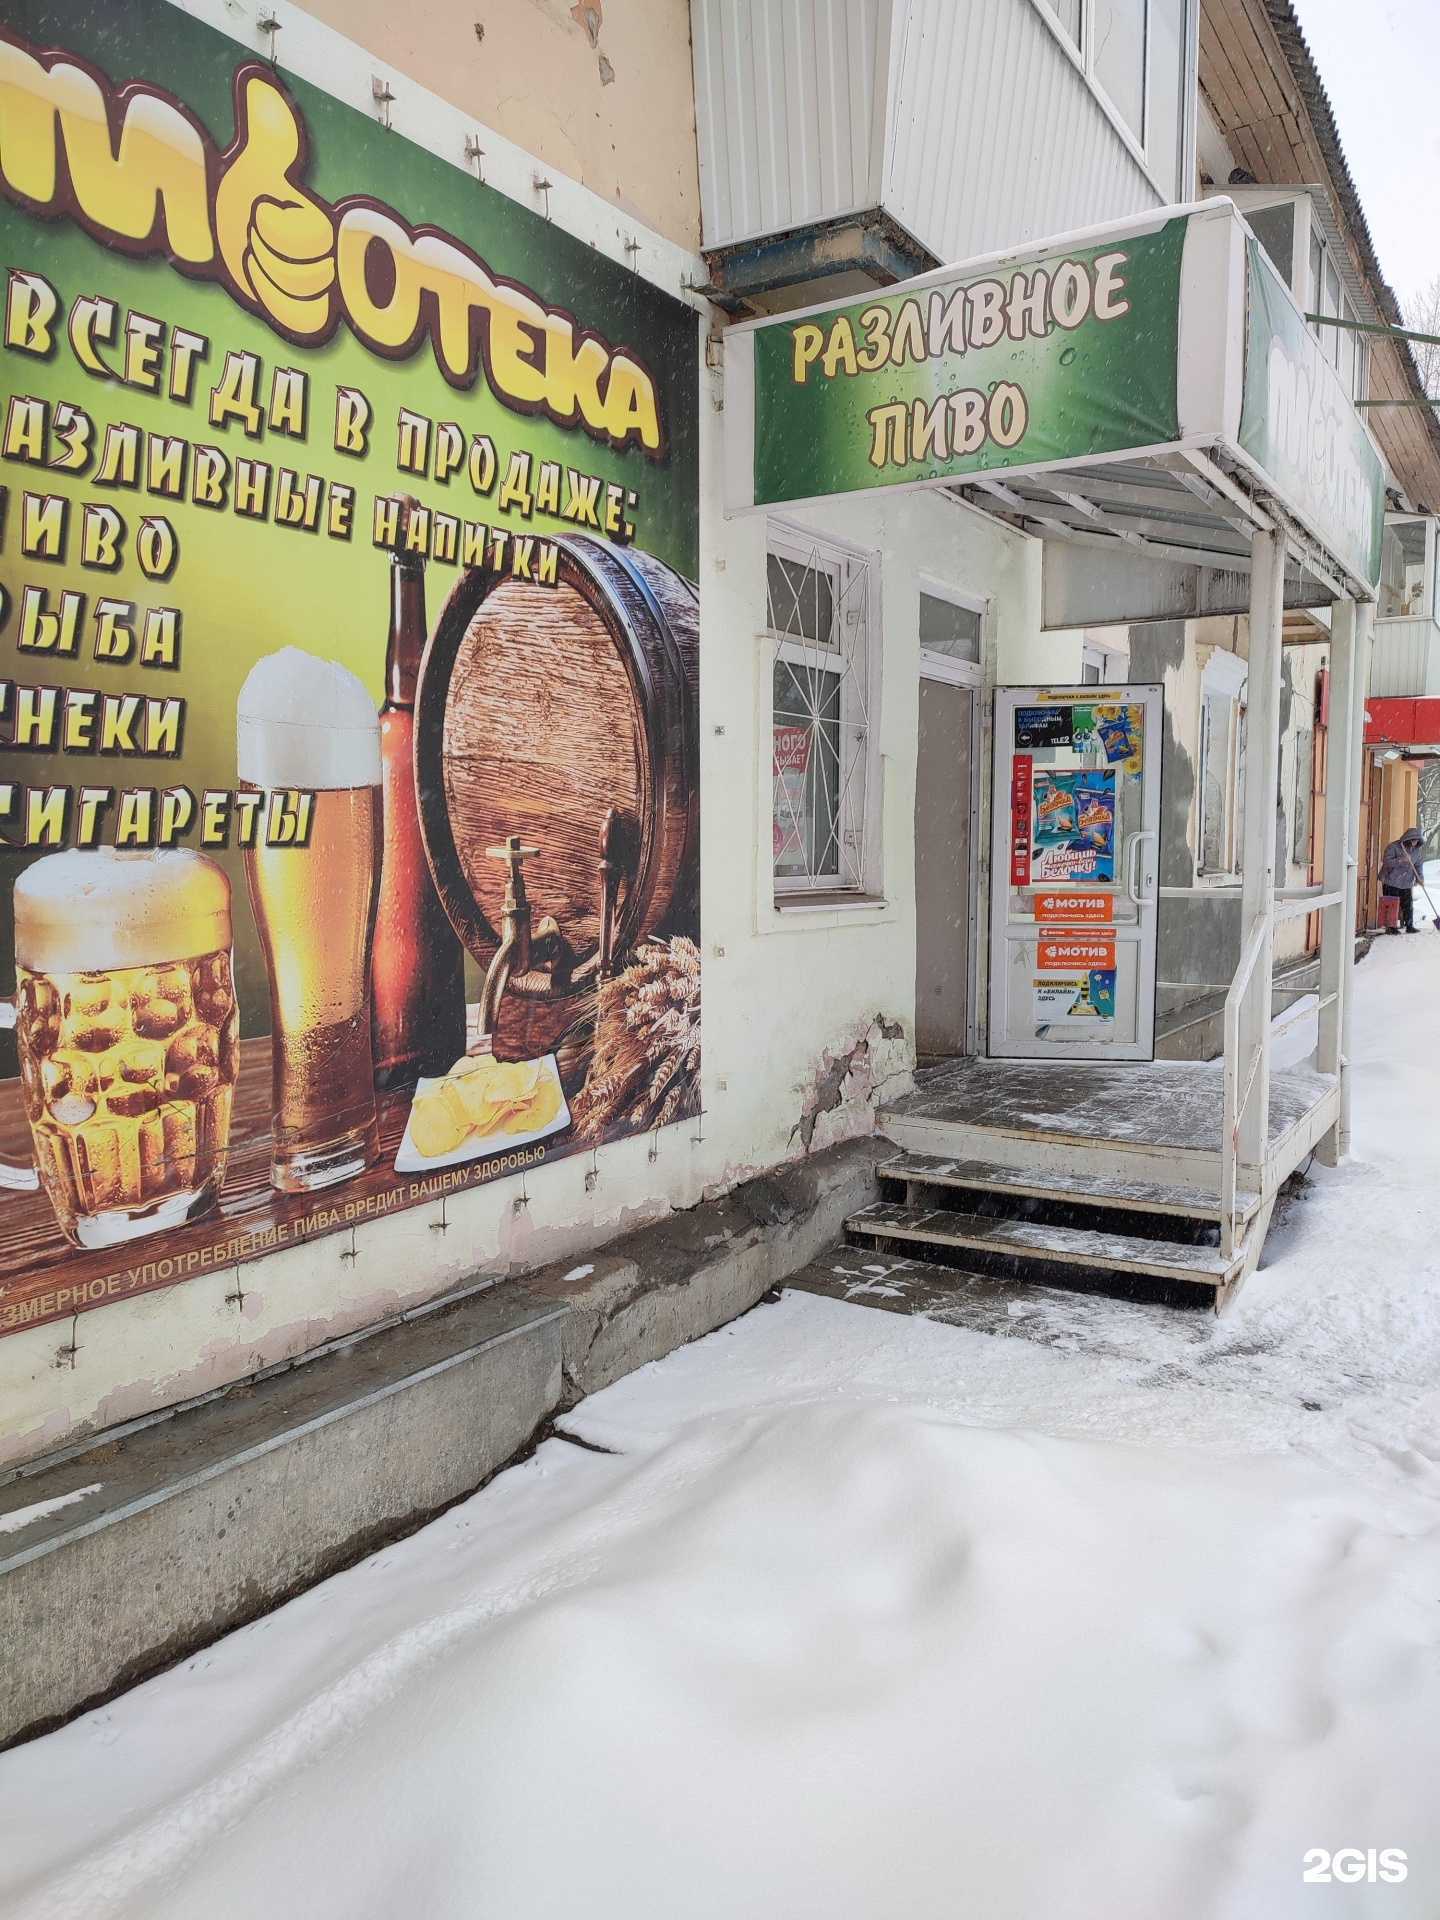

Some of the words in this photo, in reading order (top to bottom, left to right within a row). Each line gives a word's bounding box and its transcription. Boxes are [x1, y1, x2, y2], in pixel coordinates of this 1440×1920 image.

[791, 251, 1132, 385] РАЗЛИВНОЕ
[3, 267, 312, 441] ВСЕГДА
[333, 384, 374, 458] В
[396, 406, 640, 537] ПРОДАЖЕ:
[866, 380, 1029, 470] ПИВО
[373, 495, 562, 588] НАПИТКИ
[0, 585, 182, 670] ЫБА
[1050, 735, 1070, 744] TELE2
[1055, 898, 1105, 909] МОТИВ
[1058, 946, 1108, 957] МОТИВ
[128, 1223, 289, 1289] УПОТРЕБЛЕНИЕ
[294, 1209, 341, 1238] ПИВА
[345, 1187, 406, 1222] ВРЕДИТ
[410, 1167, 470, 1200] ВАШЕМУ
[473, 1145, 547, 1184] ЗДОРОВЬЮ
